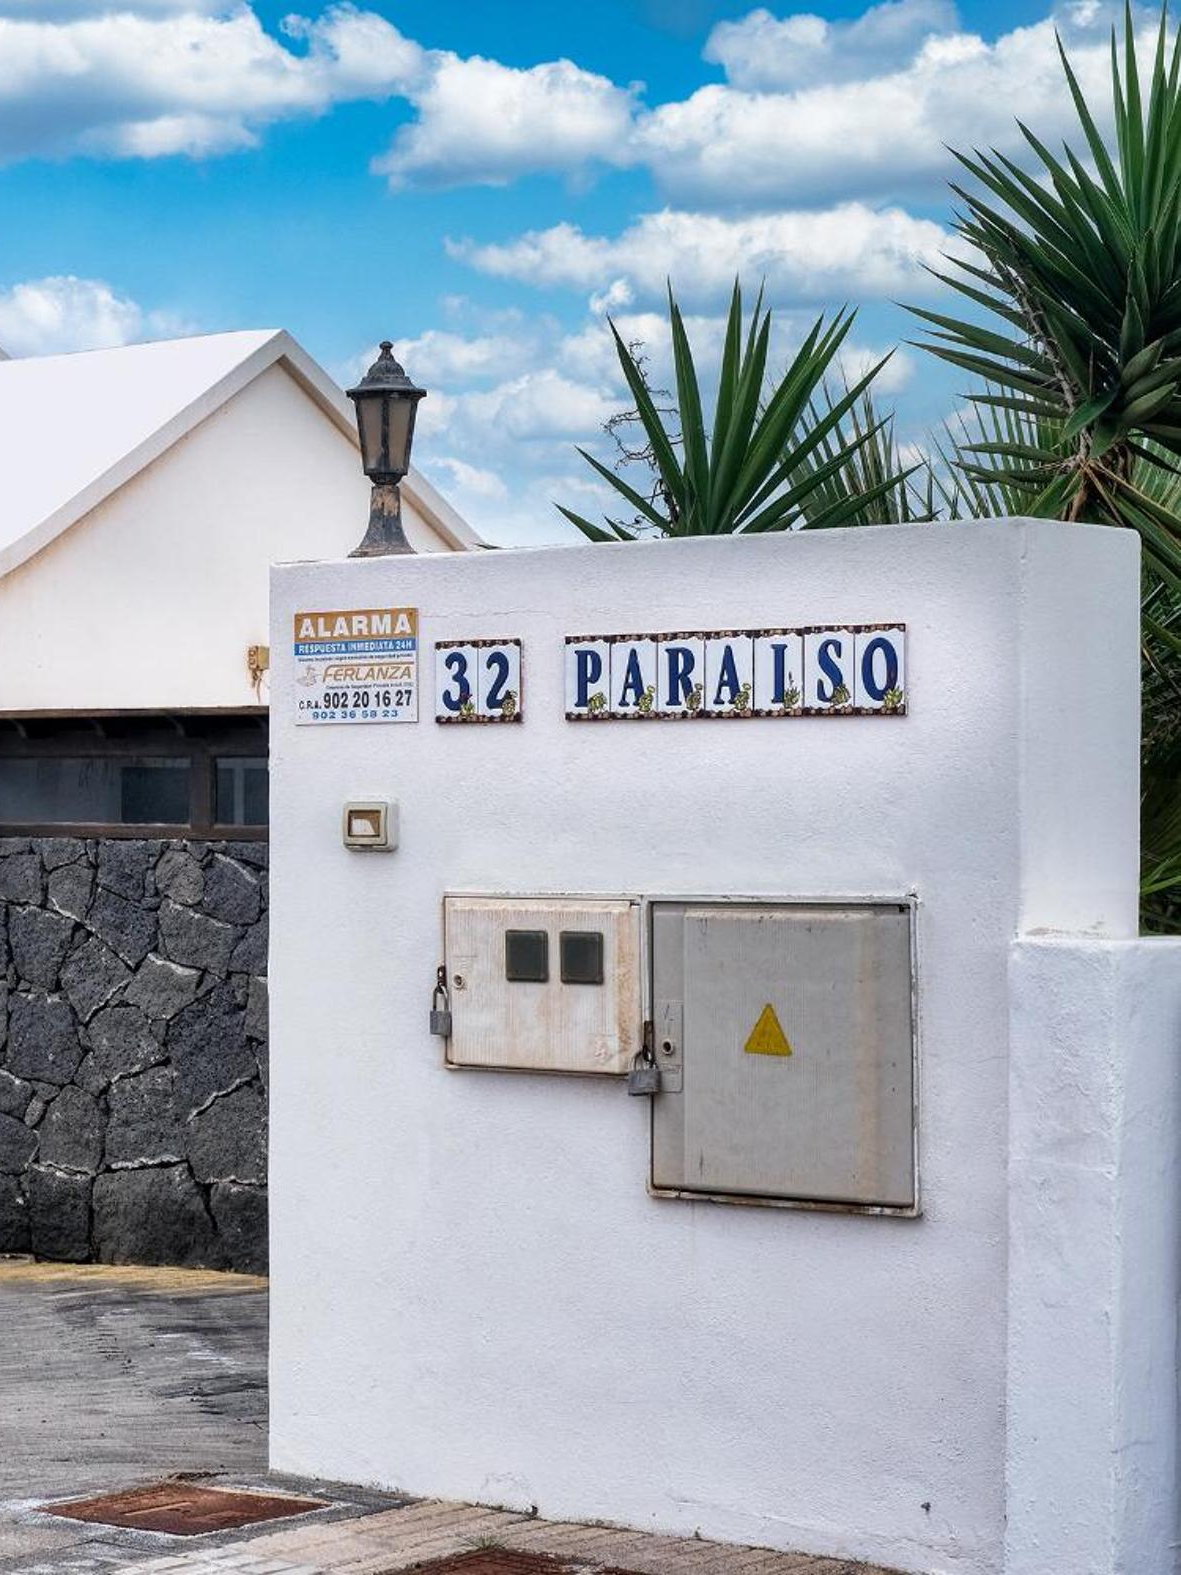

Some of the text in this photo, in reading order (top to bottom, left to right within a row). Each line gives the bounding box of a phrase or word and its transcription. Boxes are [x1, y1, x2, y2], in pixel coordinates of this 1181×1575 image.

[299, 613, 412, 638] ALARMA
[299, 643, 346, 654] RESPUESTA
[395, 640, 412, 649] 24H
[322, 661, 414, 682] FERLANZA
[442, 651, 515, 712] 32
[574, 637, 899, 708] PARAISO
[323, 693, 349, 709] 902
[352, 691, 370, 708] 20
[374, 690, 391, 707] 16
[395, 690, 412, 706] 27
[312, 710, 337, 719] 902
[341, 710, 357, 719] 36
[381, 708, 399, 718] 23
